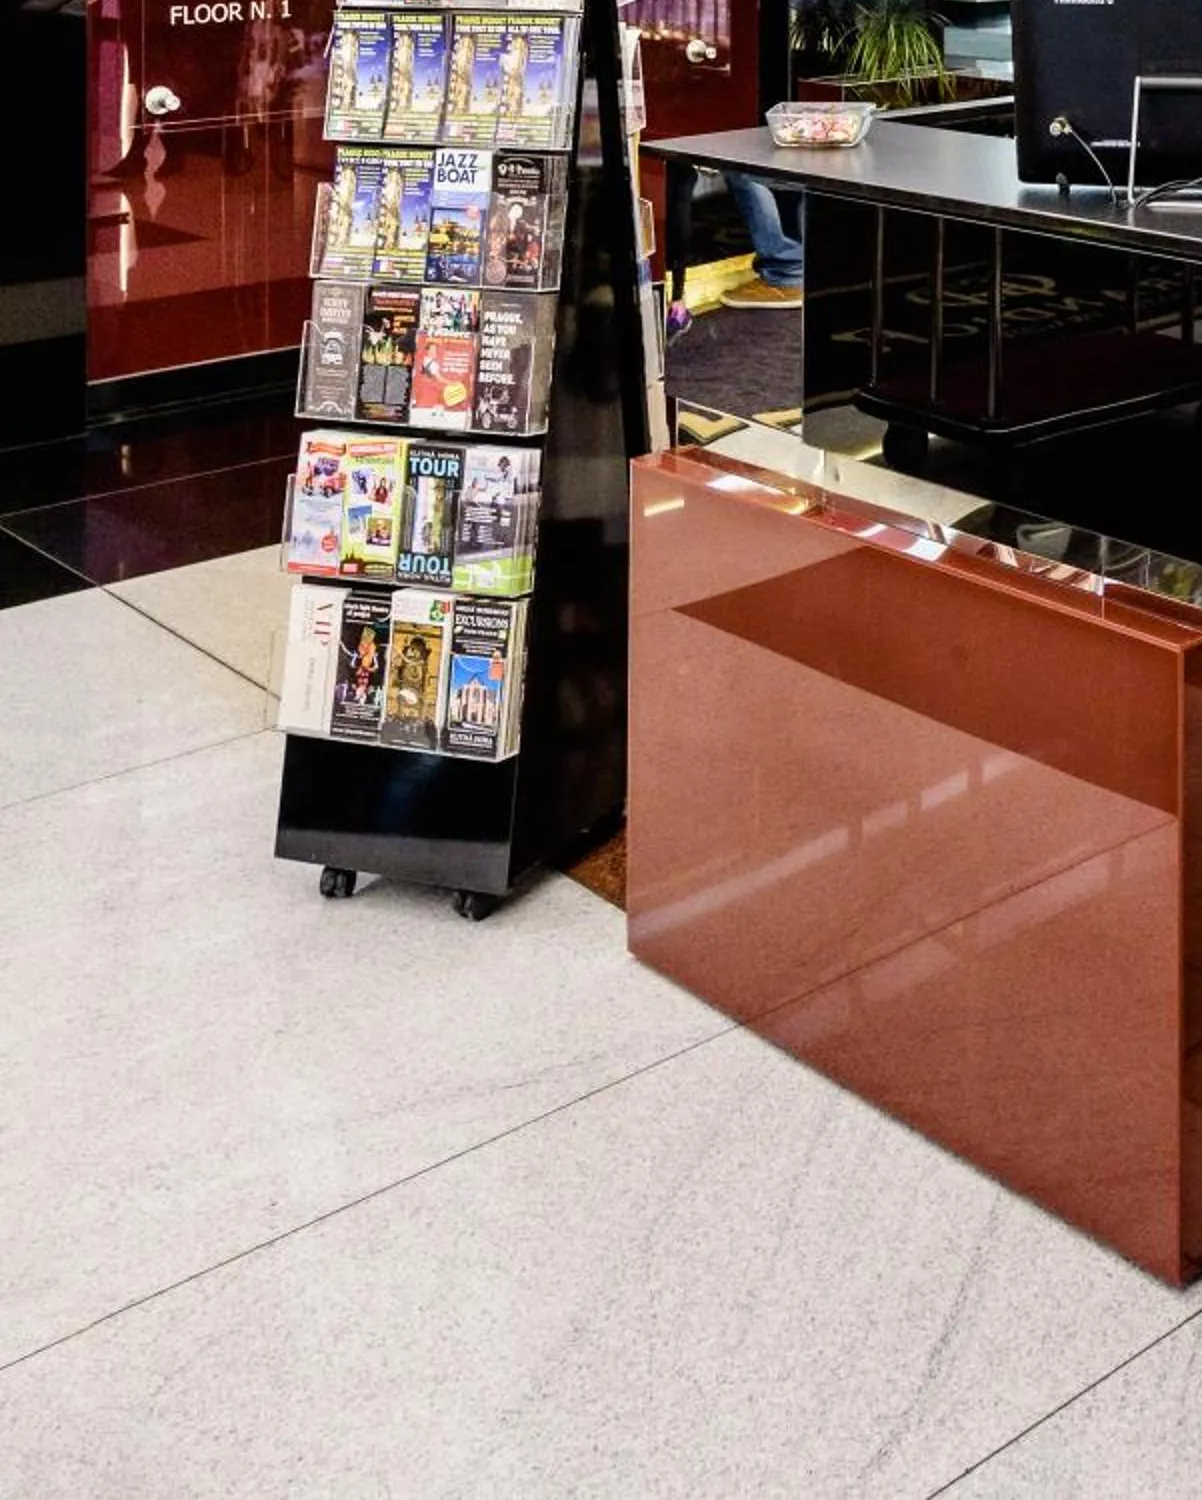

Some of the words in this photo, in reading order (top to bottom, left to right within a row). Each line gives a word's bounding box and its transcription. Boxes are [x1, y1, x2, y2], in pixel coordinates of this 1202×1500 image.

[169, 2, 244, 26] FLOOR
[250, 0, 272, 20] N.
[437, 153, 478, 168] JAZZ
[437, 169, 478, 184] BOAT
[409, 457, 460, 477] TOUR
[398, 553, 450, 574] TOUR
